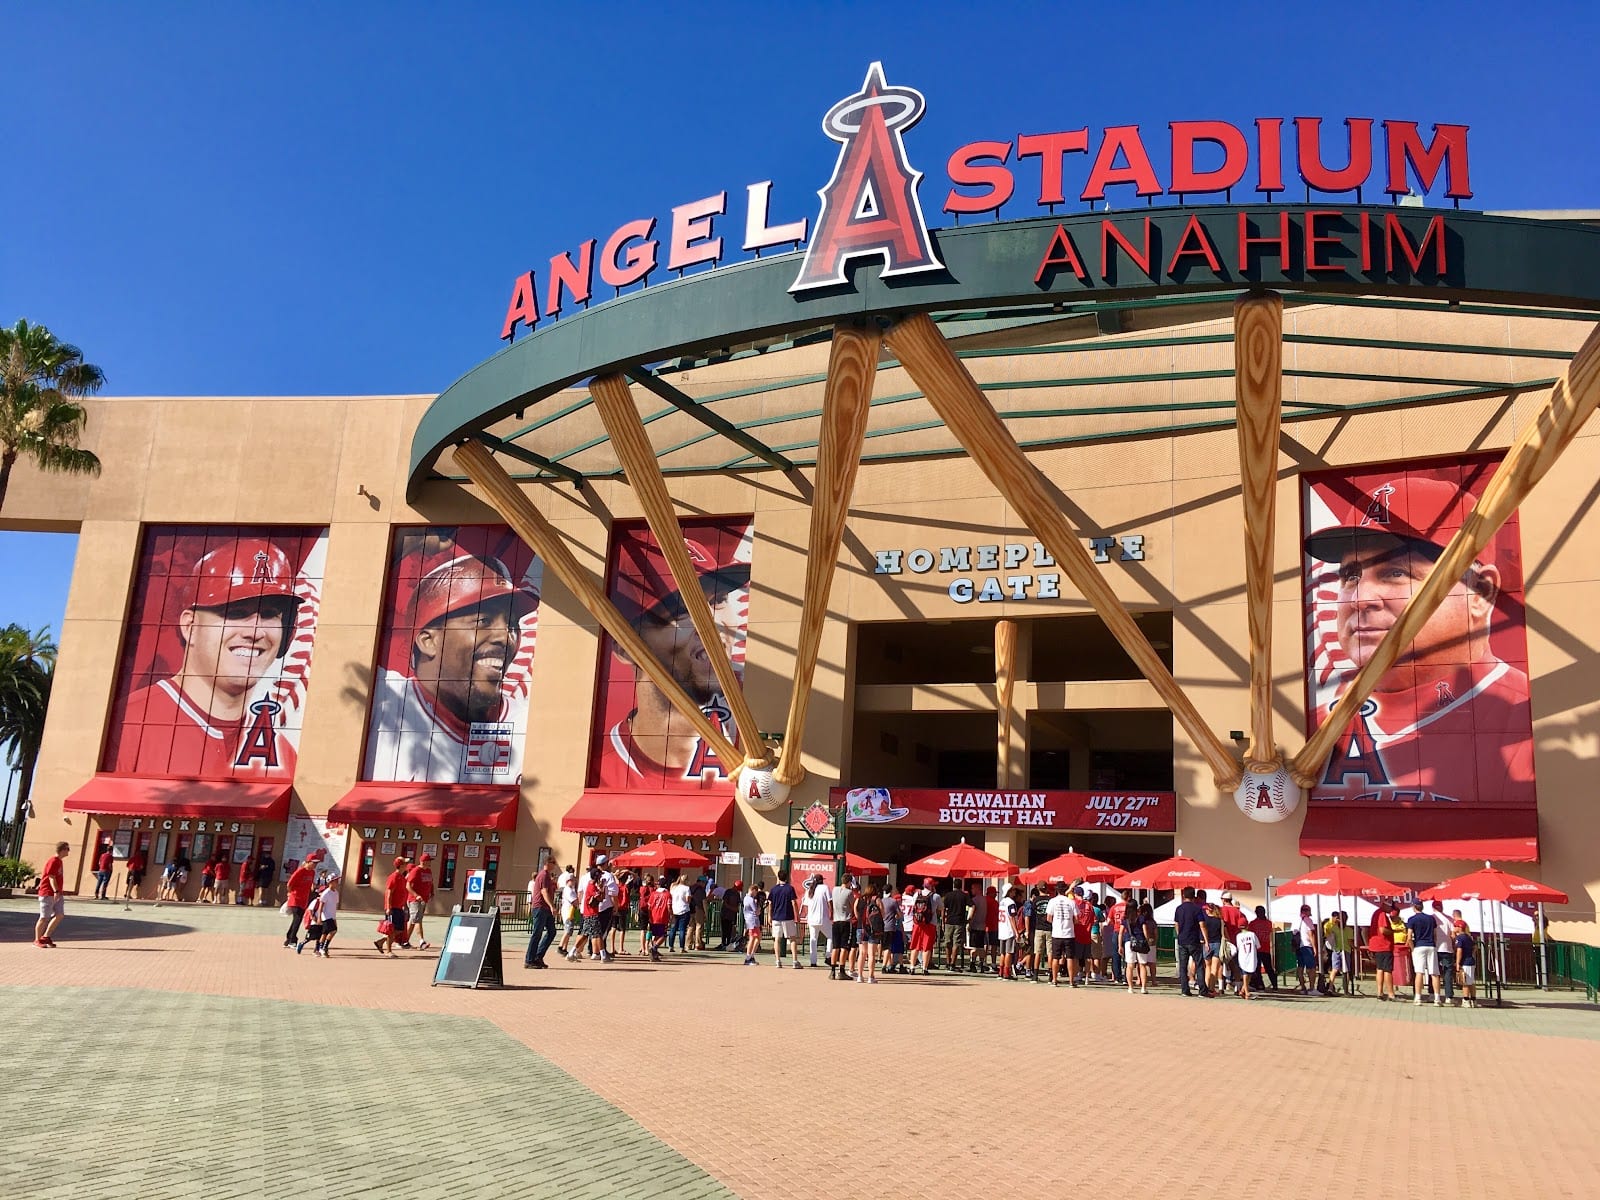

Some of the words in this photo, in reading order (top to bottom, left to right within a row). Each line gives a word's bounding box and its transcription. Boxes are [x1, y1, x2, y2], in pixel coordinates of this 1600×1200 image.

[500, 180, 807, 341] ANGEL
[787, 61, 945, 293] A
[943, 117, 1473, 214] STADIUM
[1034, 210, 1448, 283] ANAHEIM
[874, 535, 1145, 574] HOMEPLTE
[948, 574, 1060, 603] GATE
[948, 793, 1046, 808] HAWAIIAN
[1085, 796, 1125, 810] JULY
[1125, 796, 1159, 810] 27TH
[939, 809, 1013, 824] BUCKET
[1016, 810, 1056, 825] HAT
[1096, 812, 1131, 826] 7:07
[1130, 817, 1148, 827] PM
[133, 818, 240, 833] TICKETS
[364, 827, 422, 840] WILL
[440, 830, 500, 843] CALL
[584, 835, 645, 848] WILL
[793, 839, 838, 850] DIRECTORY
[793, 863, 834, 872] WELCOME
